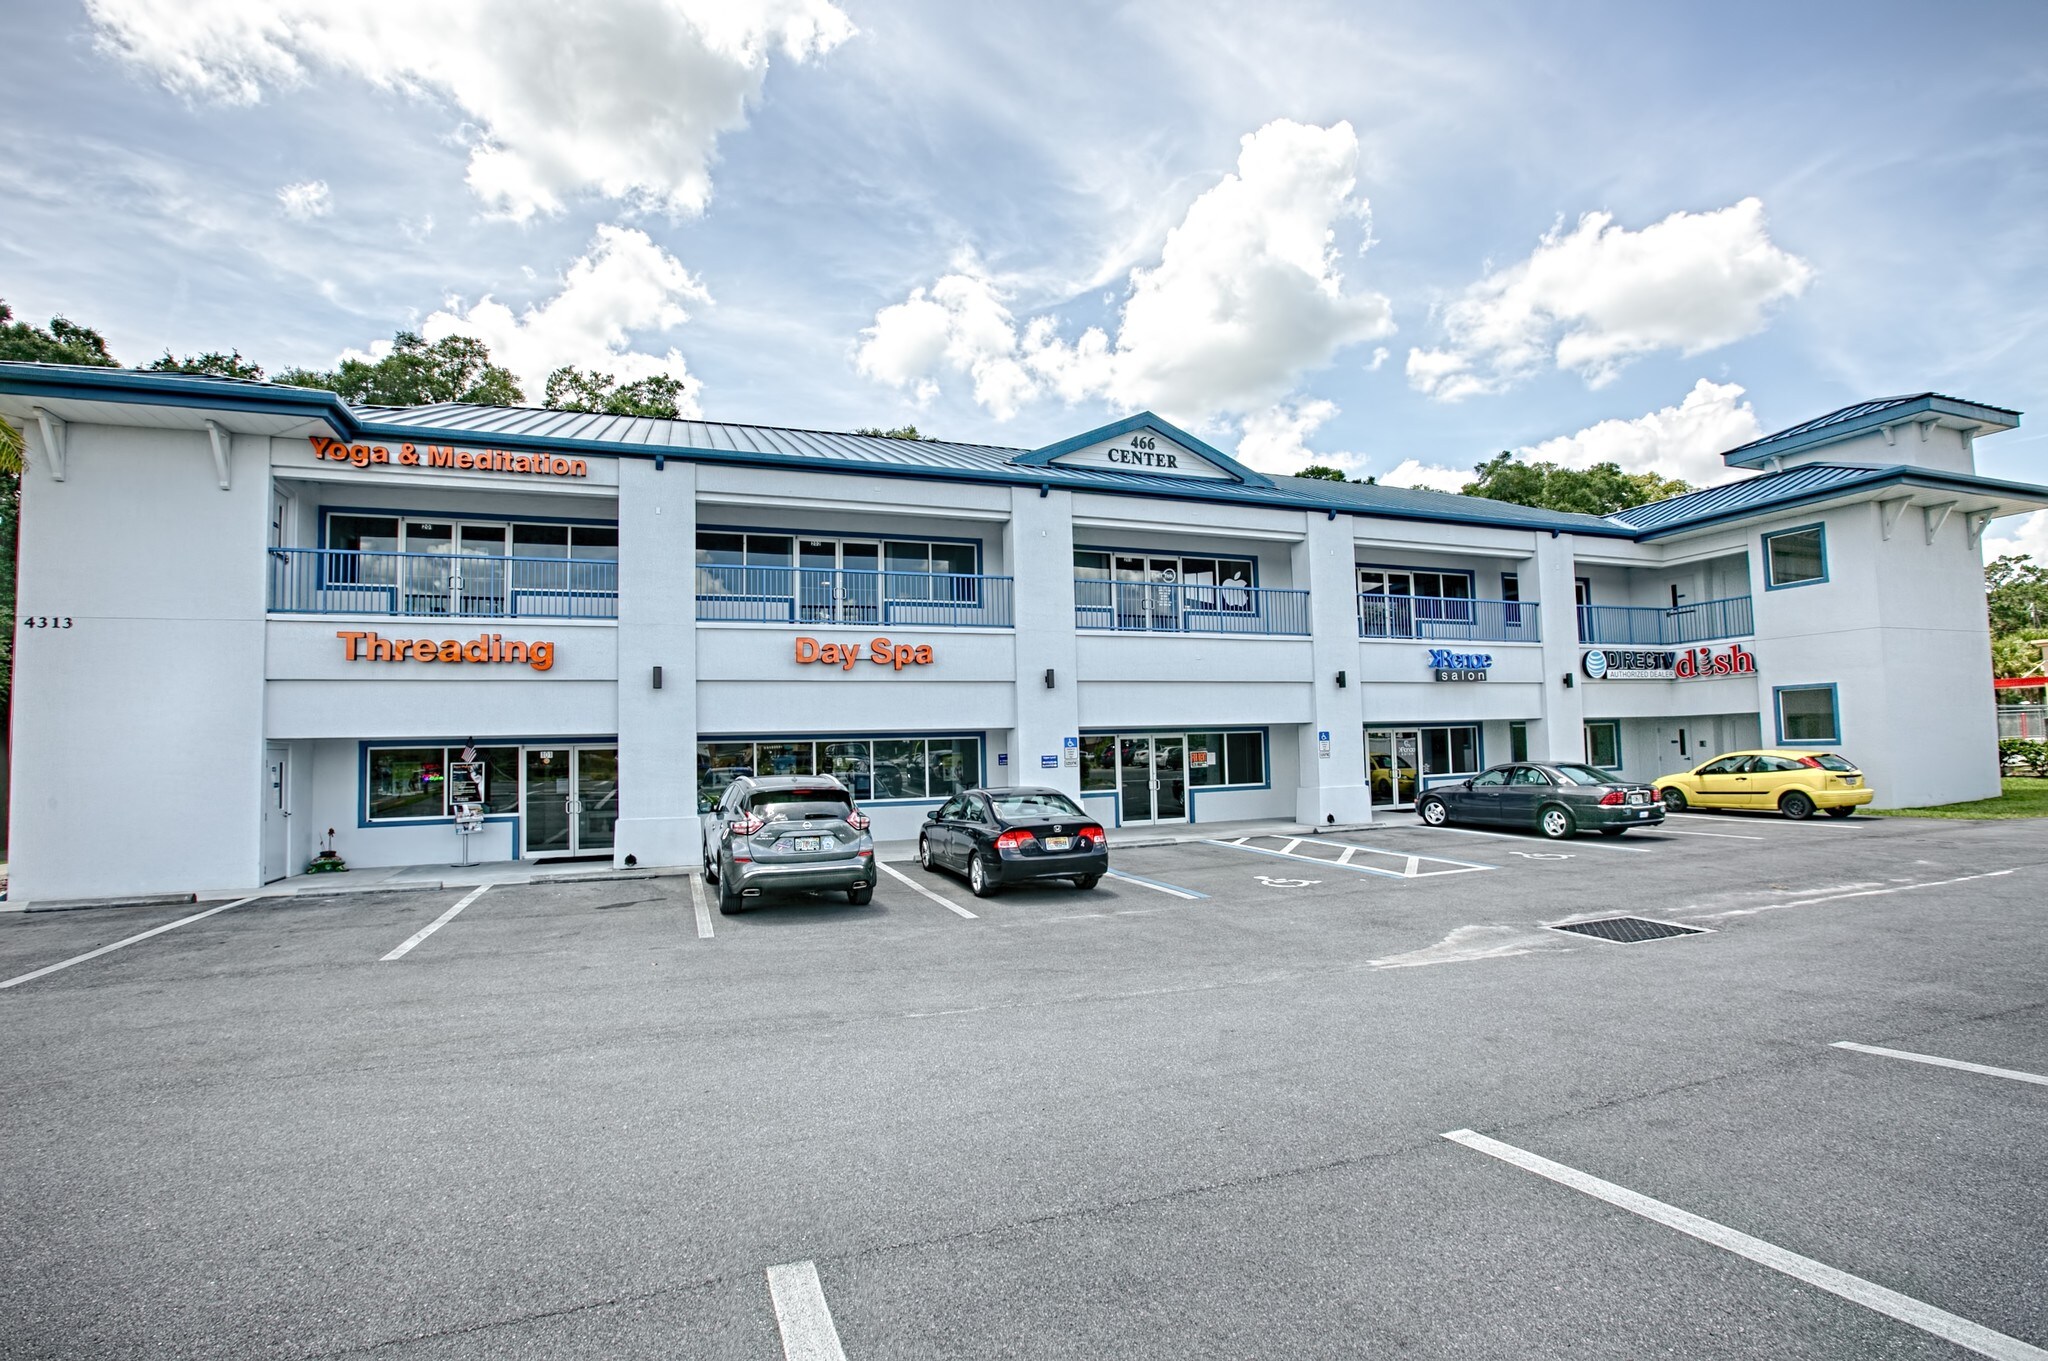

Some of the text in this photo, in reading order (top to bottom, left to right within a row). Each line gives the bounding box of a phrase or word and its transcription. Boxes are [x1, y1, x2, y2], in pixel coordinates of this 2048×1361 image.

[1131, 436, 1155, 450] 466
[309, 436, 587, 477] Yoga & Meditation
[1108, 448, 1178, 468] CENTER
[24, 616, 73, 629] 4313
[336, 631, 555, 671] Threading
[796, 637, 934, 671] Day Spa
[1607, 651, 1676, 670] DIRECTV
[1675, 644, 1756, 679] dish
[1441, 670, 1485, 681] salon
